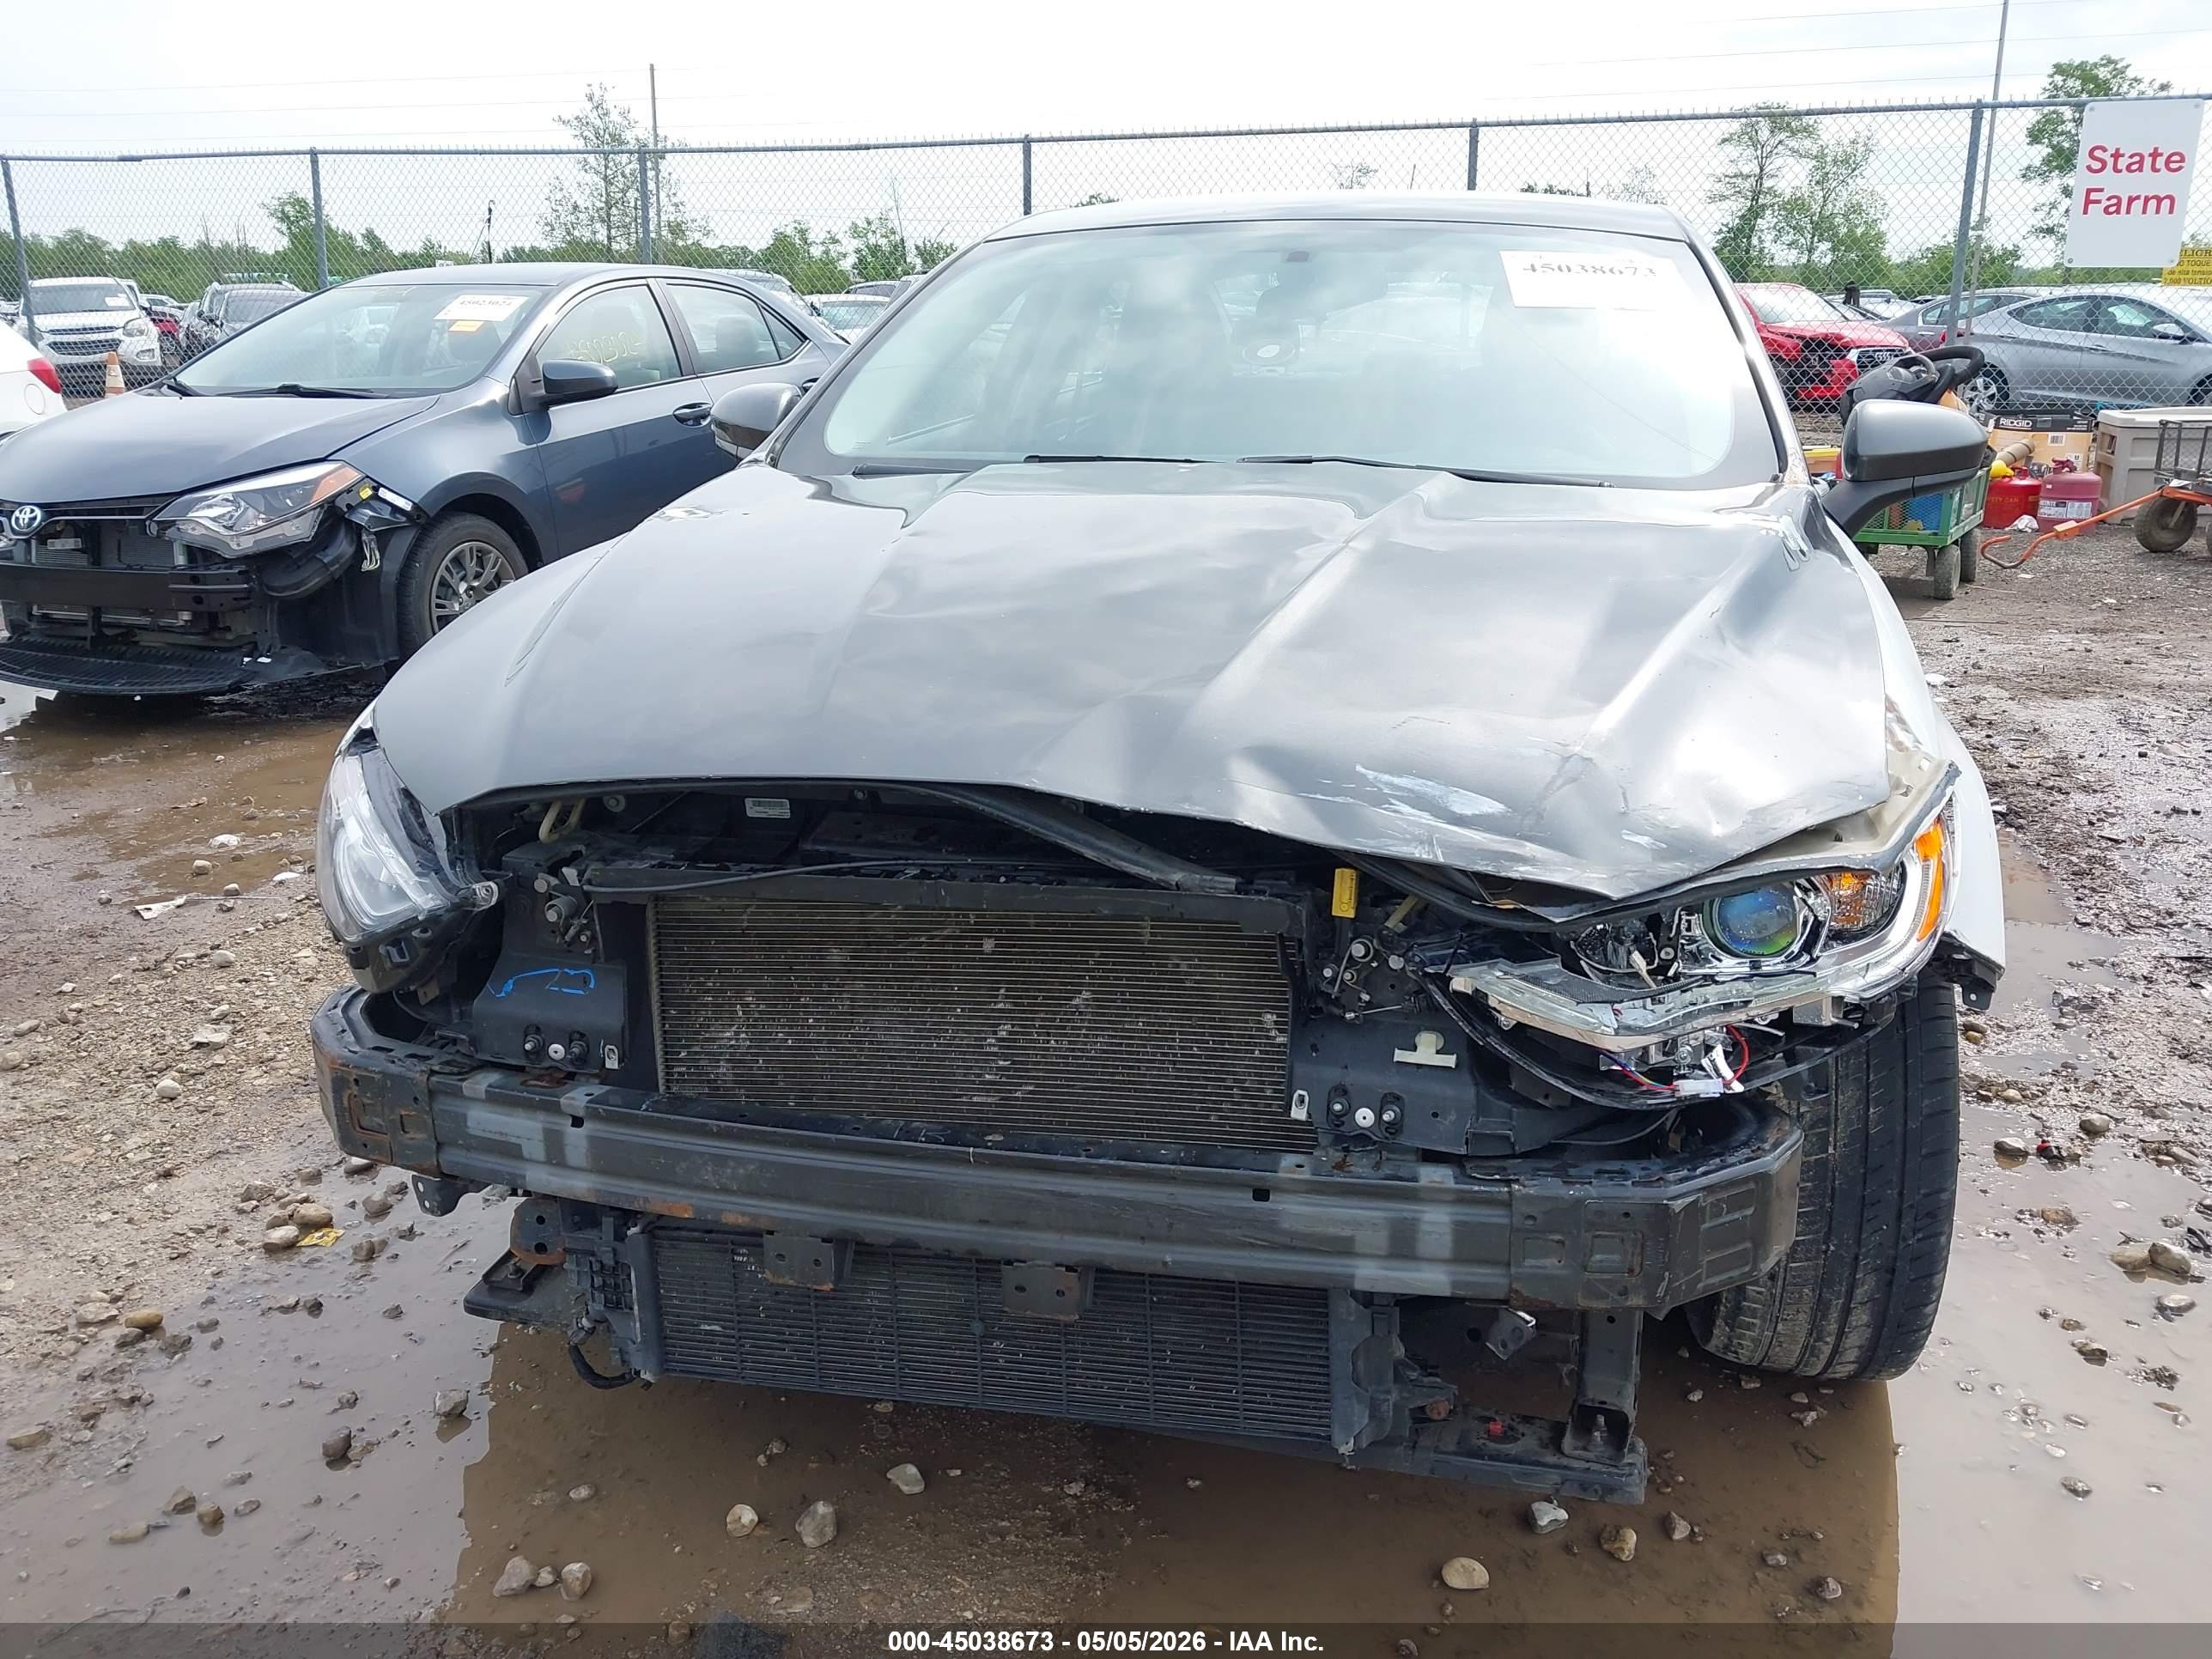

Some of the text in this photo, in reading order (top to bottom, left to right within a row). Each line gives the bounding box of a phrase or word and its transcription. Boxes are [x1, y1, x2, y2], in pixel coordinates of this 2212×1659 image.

[2086, 144, 2186, 174] State
[2082, 187, 2176, 216] Farm
[1522, 263, 1656, 276] 45038673
[1999, 417, 2033, 428] RIDGID
